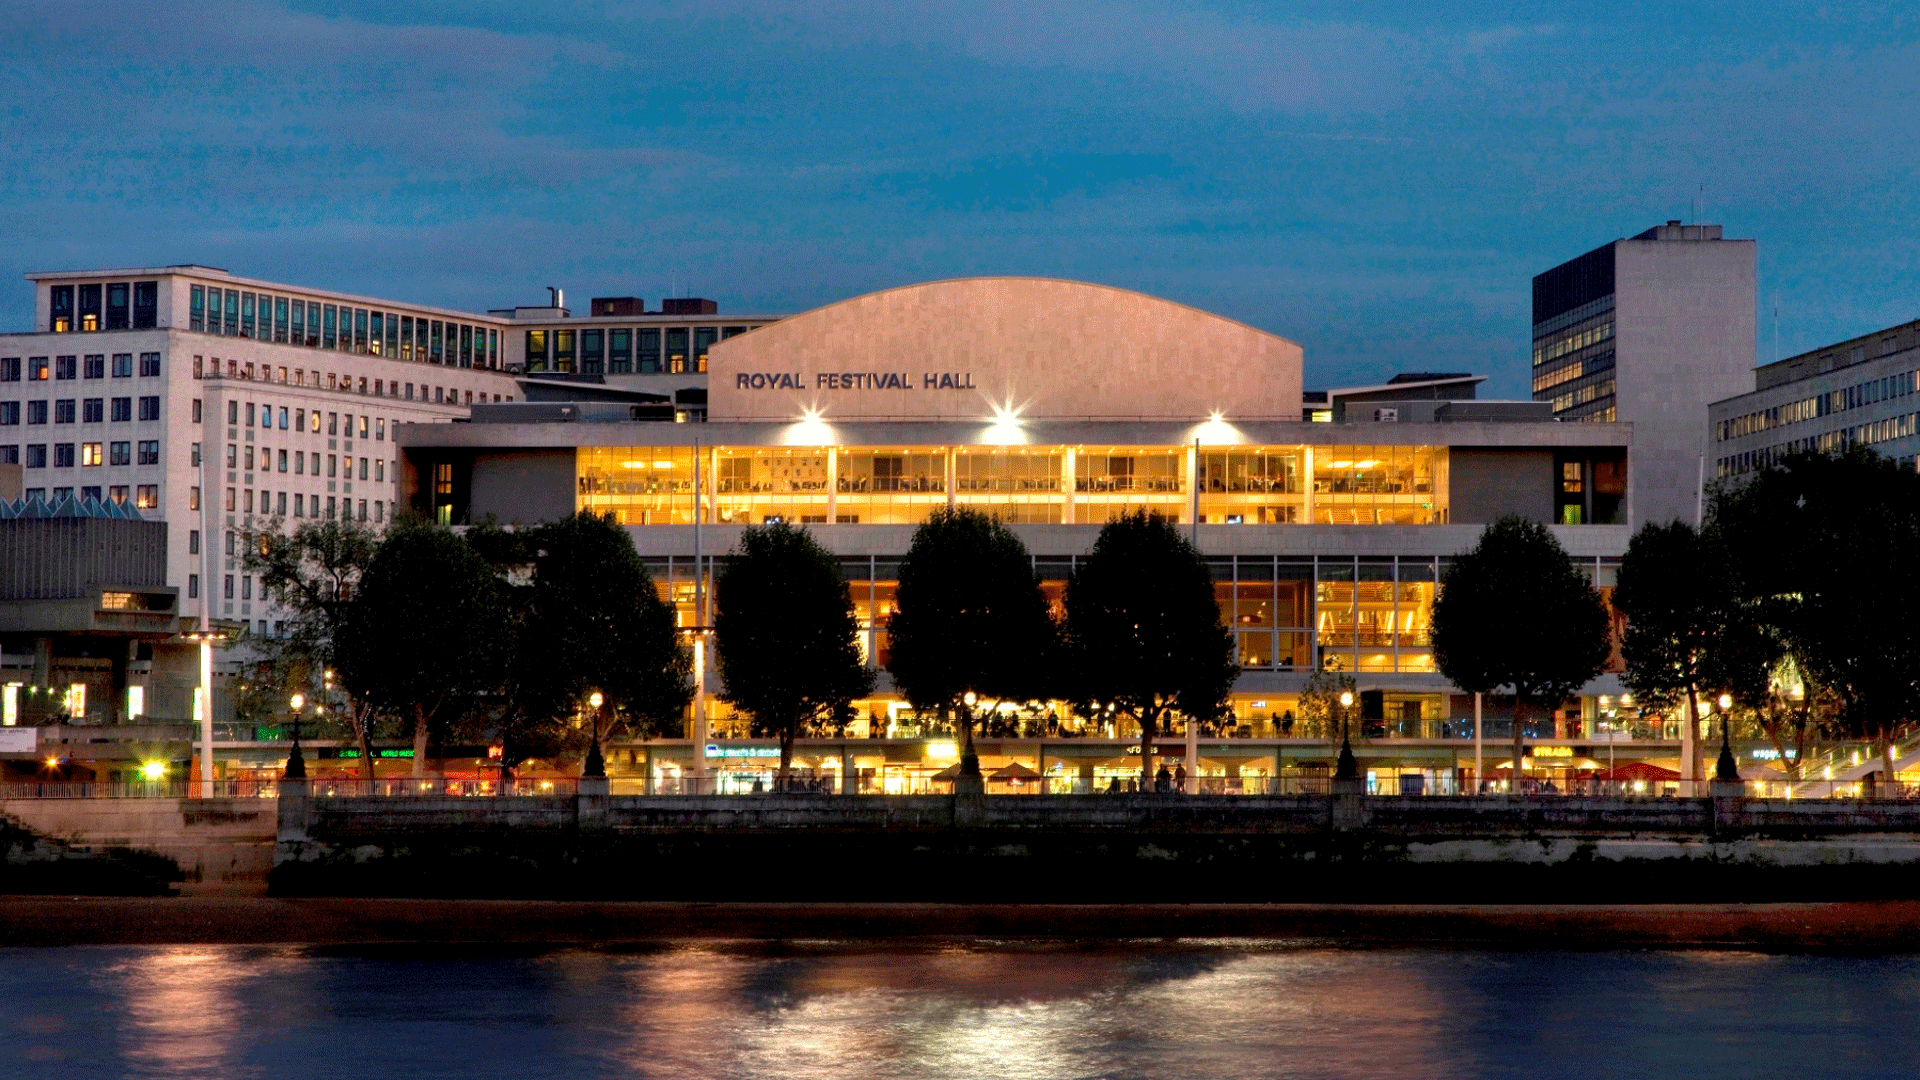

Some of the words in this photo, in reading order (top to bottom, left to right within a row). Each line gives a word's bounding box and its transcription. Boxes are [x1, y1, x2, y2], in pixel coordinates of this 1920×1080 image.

[737, 373, 805, 389] ROYAL
[817, 373, 914, 389] FESTIVAL
[924, 373, 976, 389] HALL
[1534, 747, 1572, 756] STRADA
